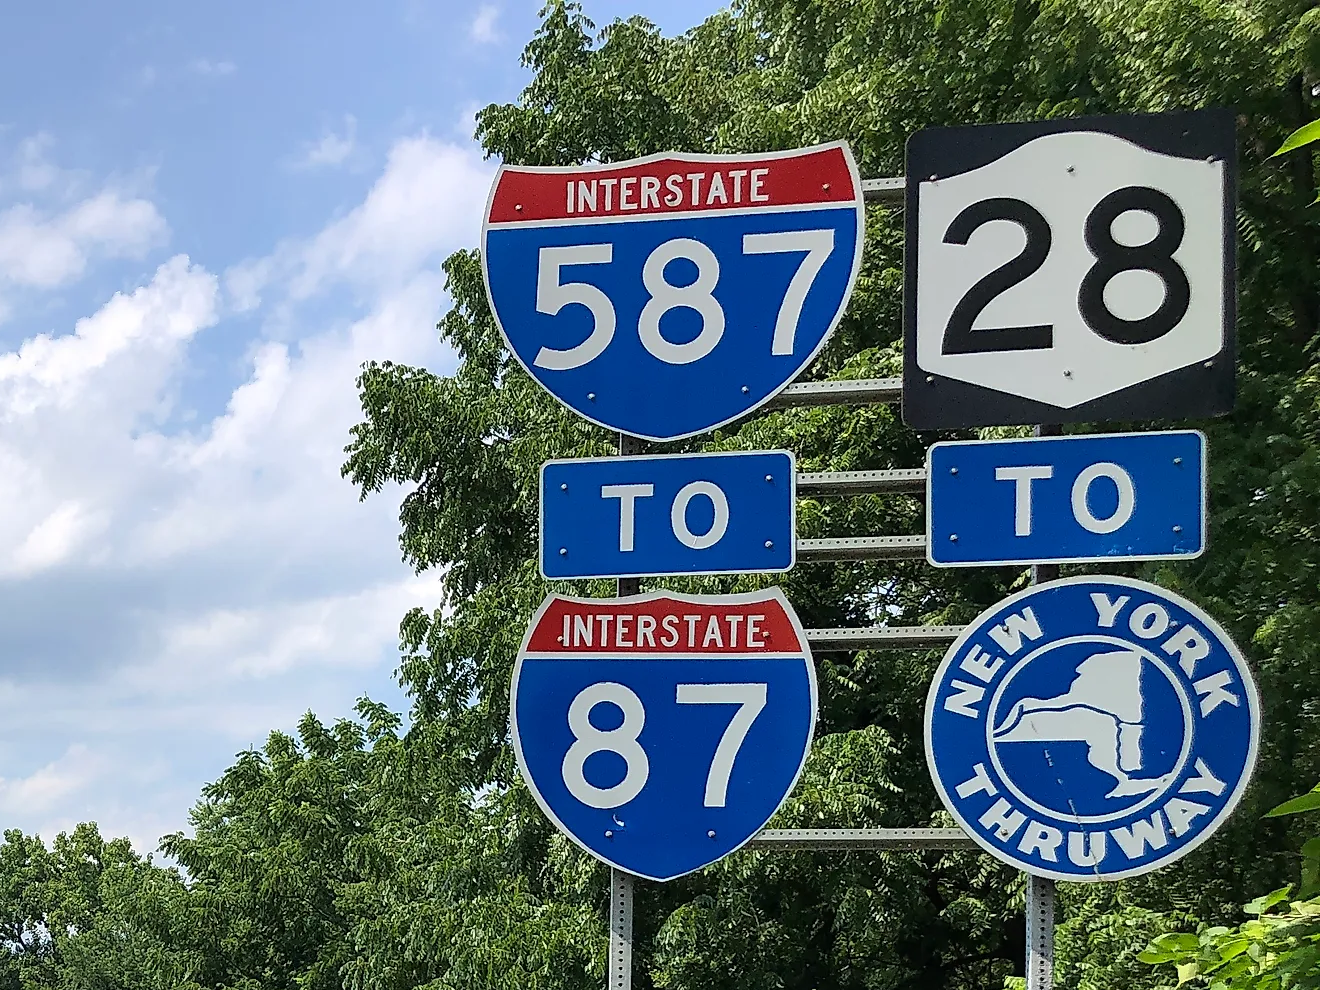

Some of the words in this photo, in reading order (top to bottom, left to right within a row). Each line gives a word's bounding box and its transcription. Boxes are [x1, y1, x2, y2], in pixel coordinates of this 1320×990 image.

[566, 168, 770, 214] INTERSTATE
[533, 228, 835, 371] 587
[941, 186, 1191, 356] 28
[601, 480, 730, 552] TO
[995, 462, 1136, 537] TO
[562, 614, 766, 649] INTERSTATE
[943, 606, 1043, 719] NEW
[1089, 592, 1240, 718] YORK
[561, 681, 768, 809] 87
[955, 756, 1227, 867] THRUWAY
